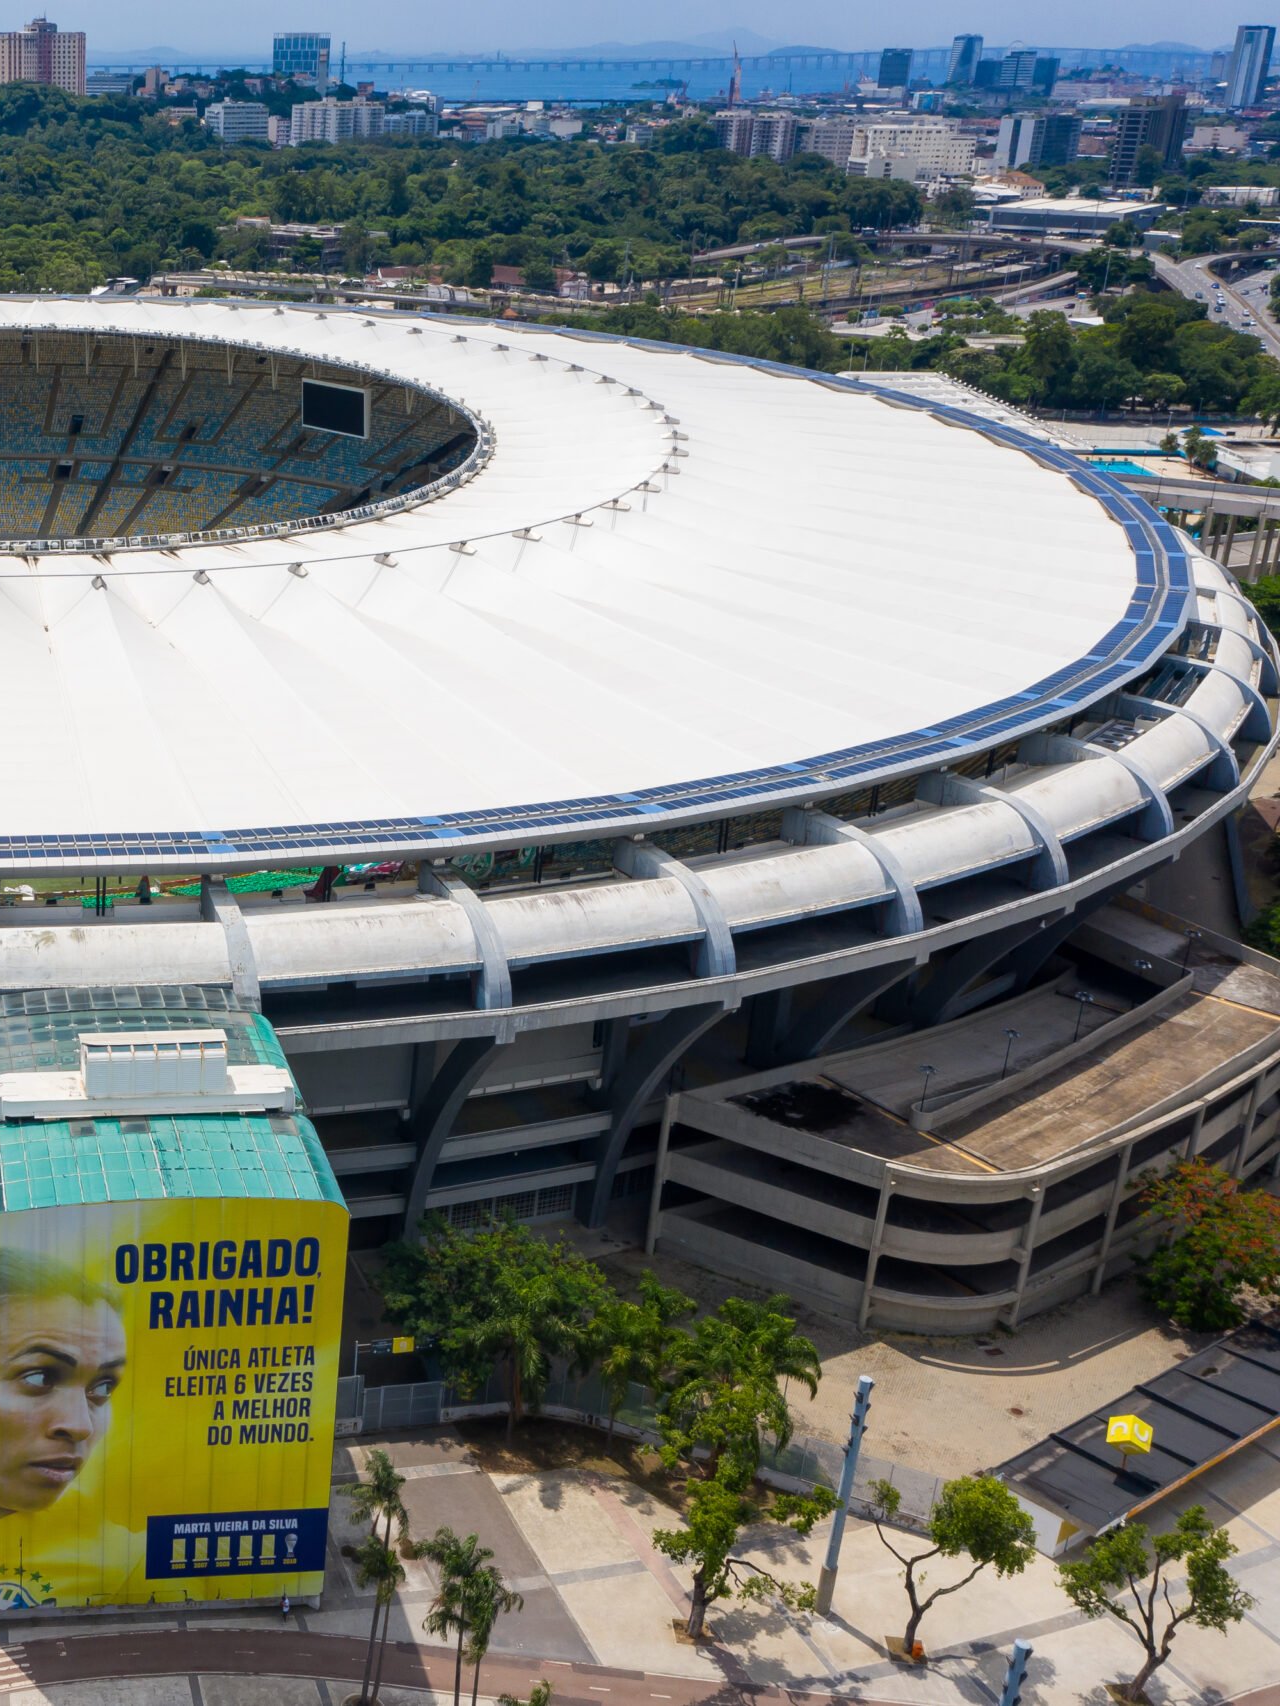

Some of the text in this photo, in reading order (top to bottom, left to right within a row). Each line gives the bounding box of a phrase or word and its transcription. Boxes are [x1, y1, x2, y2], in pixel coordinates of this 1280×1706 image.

[115, 1236, 322, 1285] OBRIGADO,
[149, 1284, 315, 1330] RAINHA!
[183, 1345, 315, 1371] ÚNICA ATLETA
[165, 1371, 314, 1398] ELEITA 6 VEZES
[213, 1397, 311, 1421] A MELHOR
[207, 1425, 233, 1446] DO
[239, 1422, 315, 1445] MUNDO.
[174, 1518, 298, 1535] MARTA VIEIRA DA SILVA
